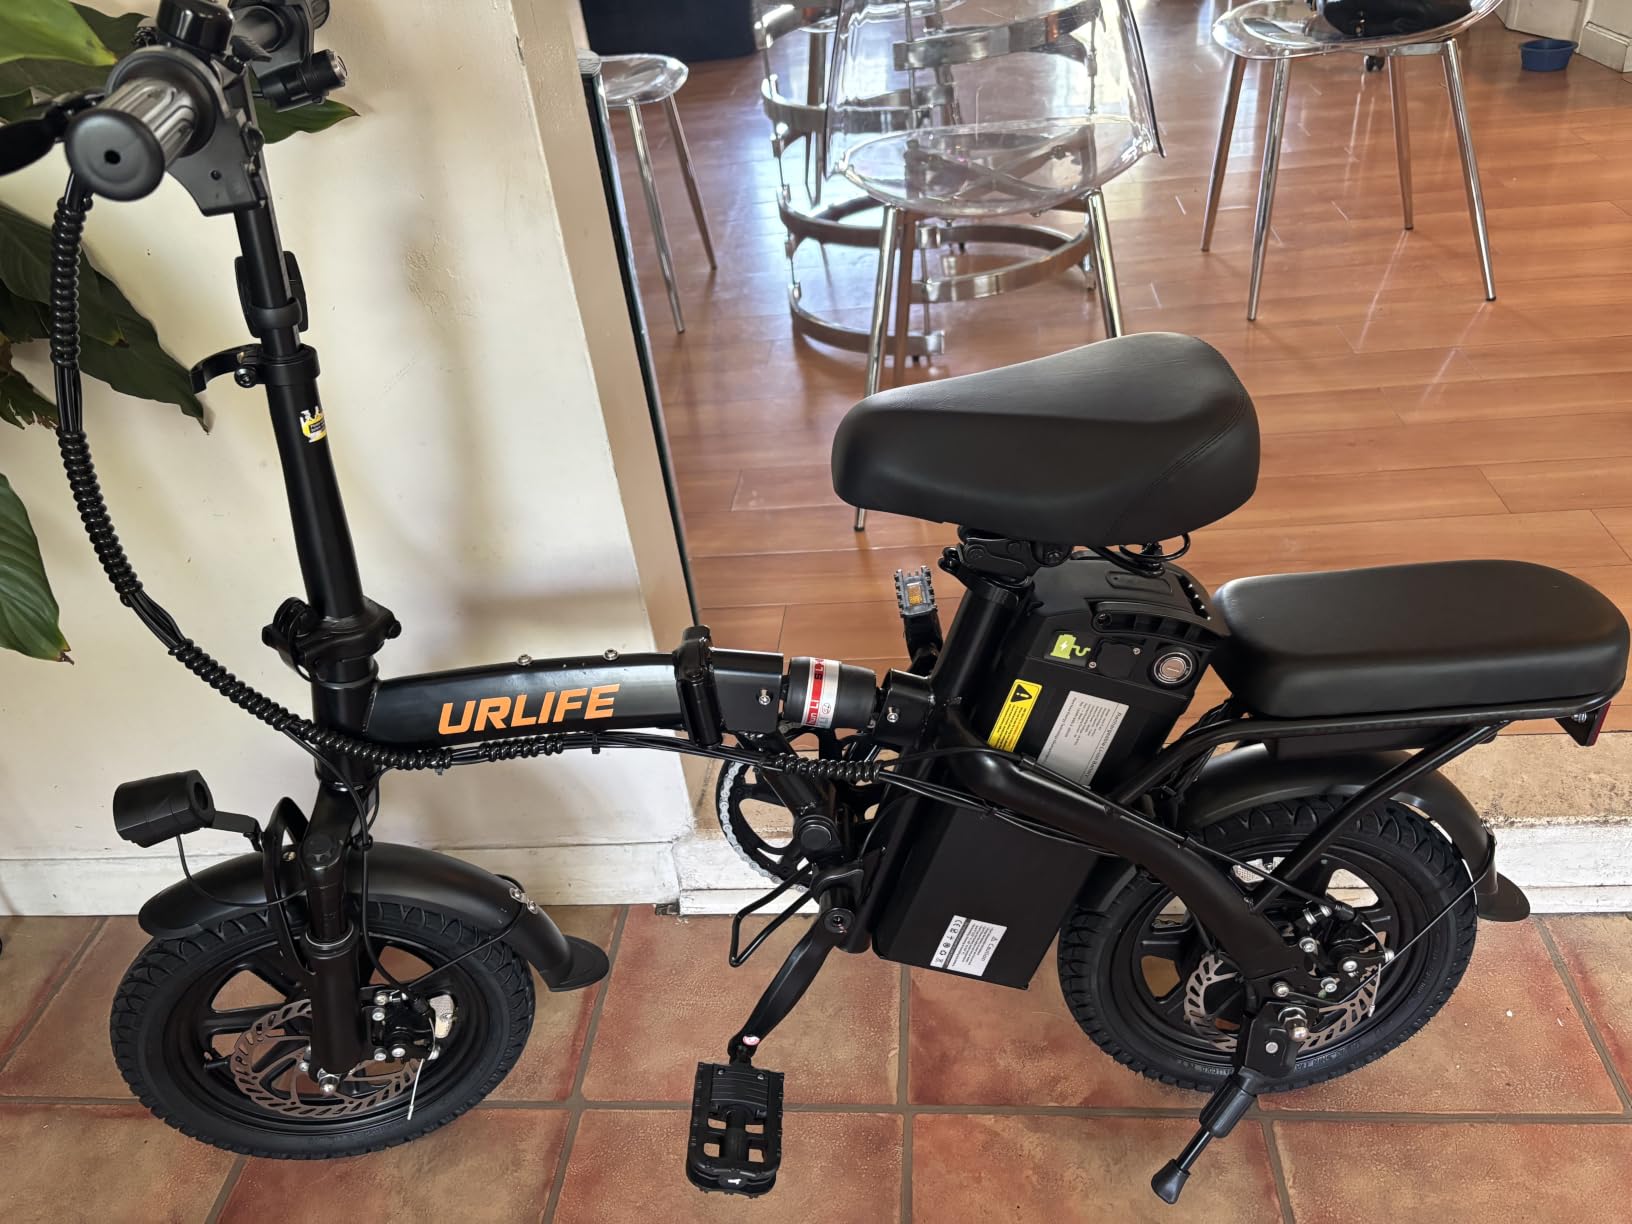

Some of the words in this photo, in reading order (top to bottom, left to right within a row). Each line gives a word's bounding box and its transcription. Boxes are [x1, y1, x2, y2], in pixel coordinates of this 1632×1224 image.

[438, 684, 620, 735] URLIFE
[1101, 712, 1122, 747] Rechargeable
[1084, 760, 1098, 778] Battery
[982, 943, 995, 961] Caution
